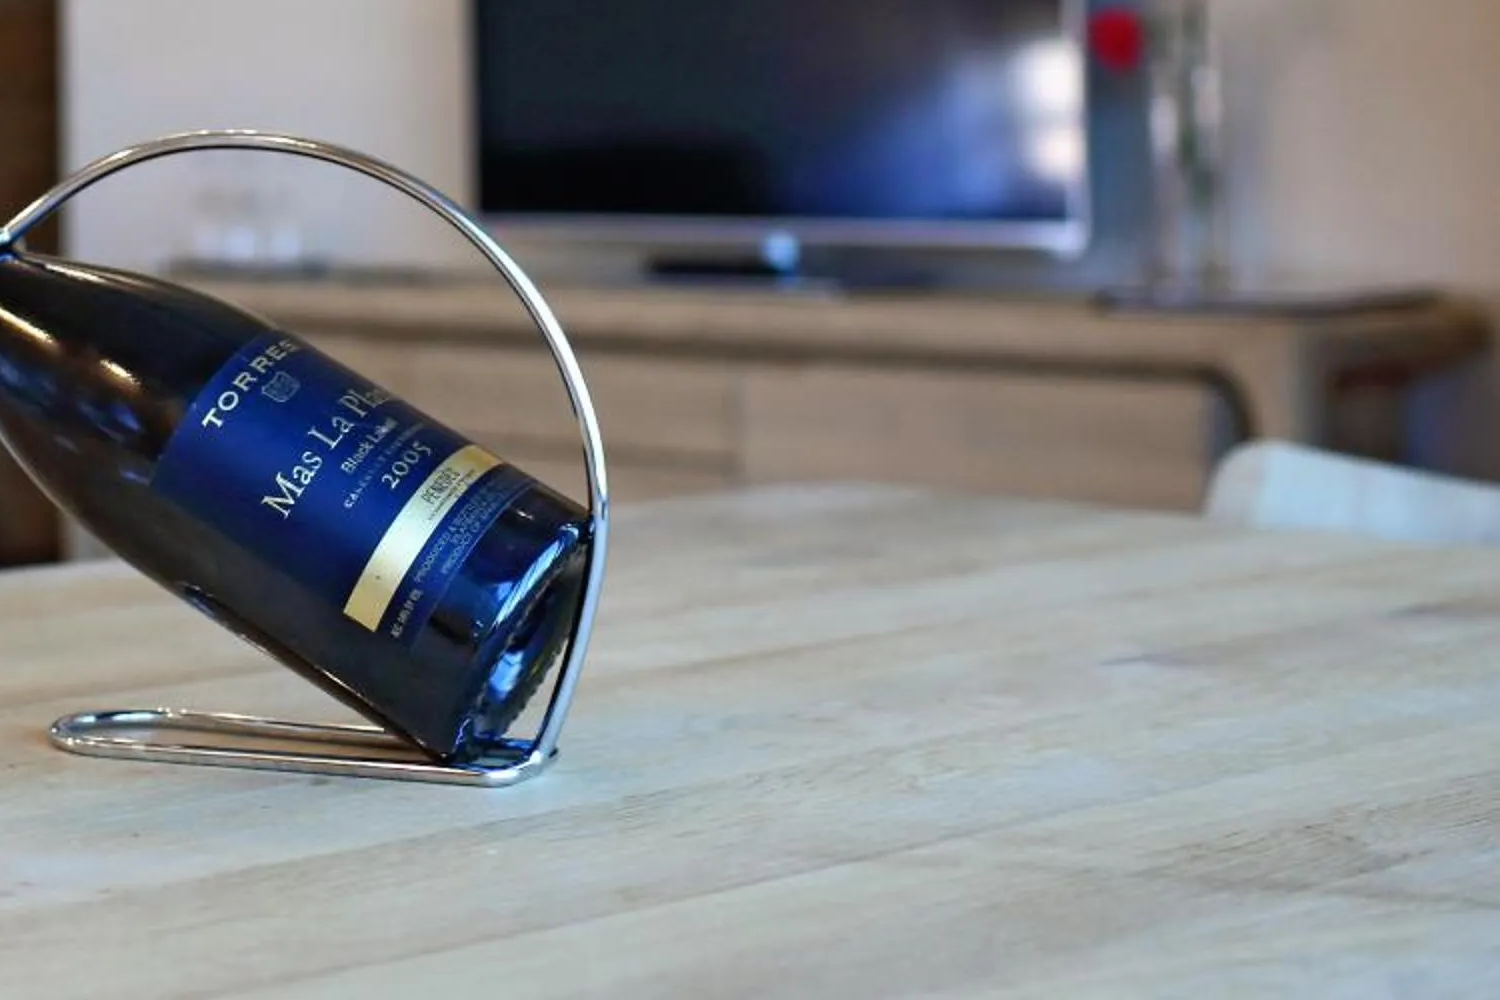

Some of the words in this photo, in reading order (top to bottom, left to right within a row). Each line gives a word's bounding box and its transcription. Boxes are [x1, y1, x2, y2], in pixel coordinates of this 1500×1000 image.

[202, 340, 298, 428] TORRES
[260, 451, 323, 519] Mas
[307, 416, 355, 450] La
[340, 441, 375, 473] Black
[381, 440, 431, 489] 2005
